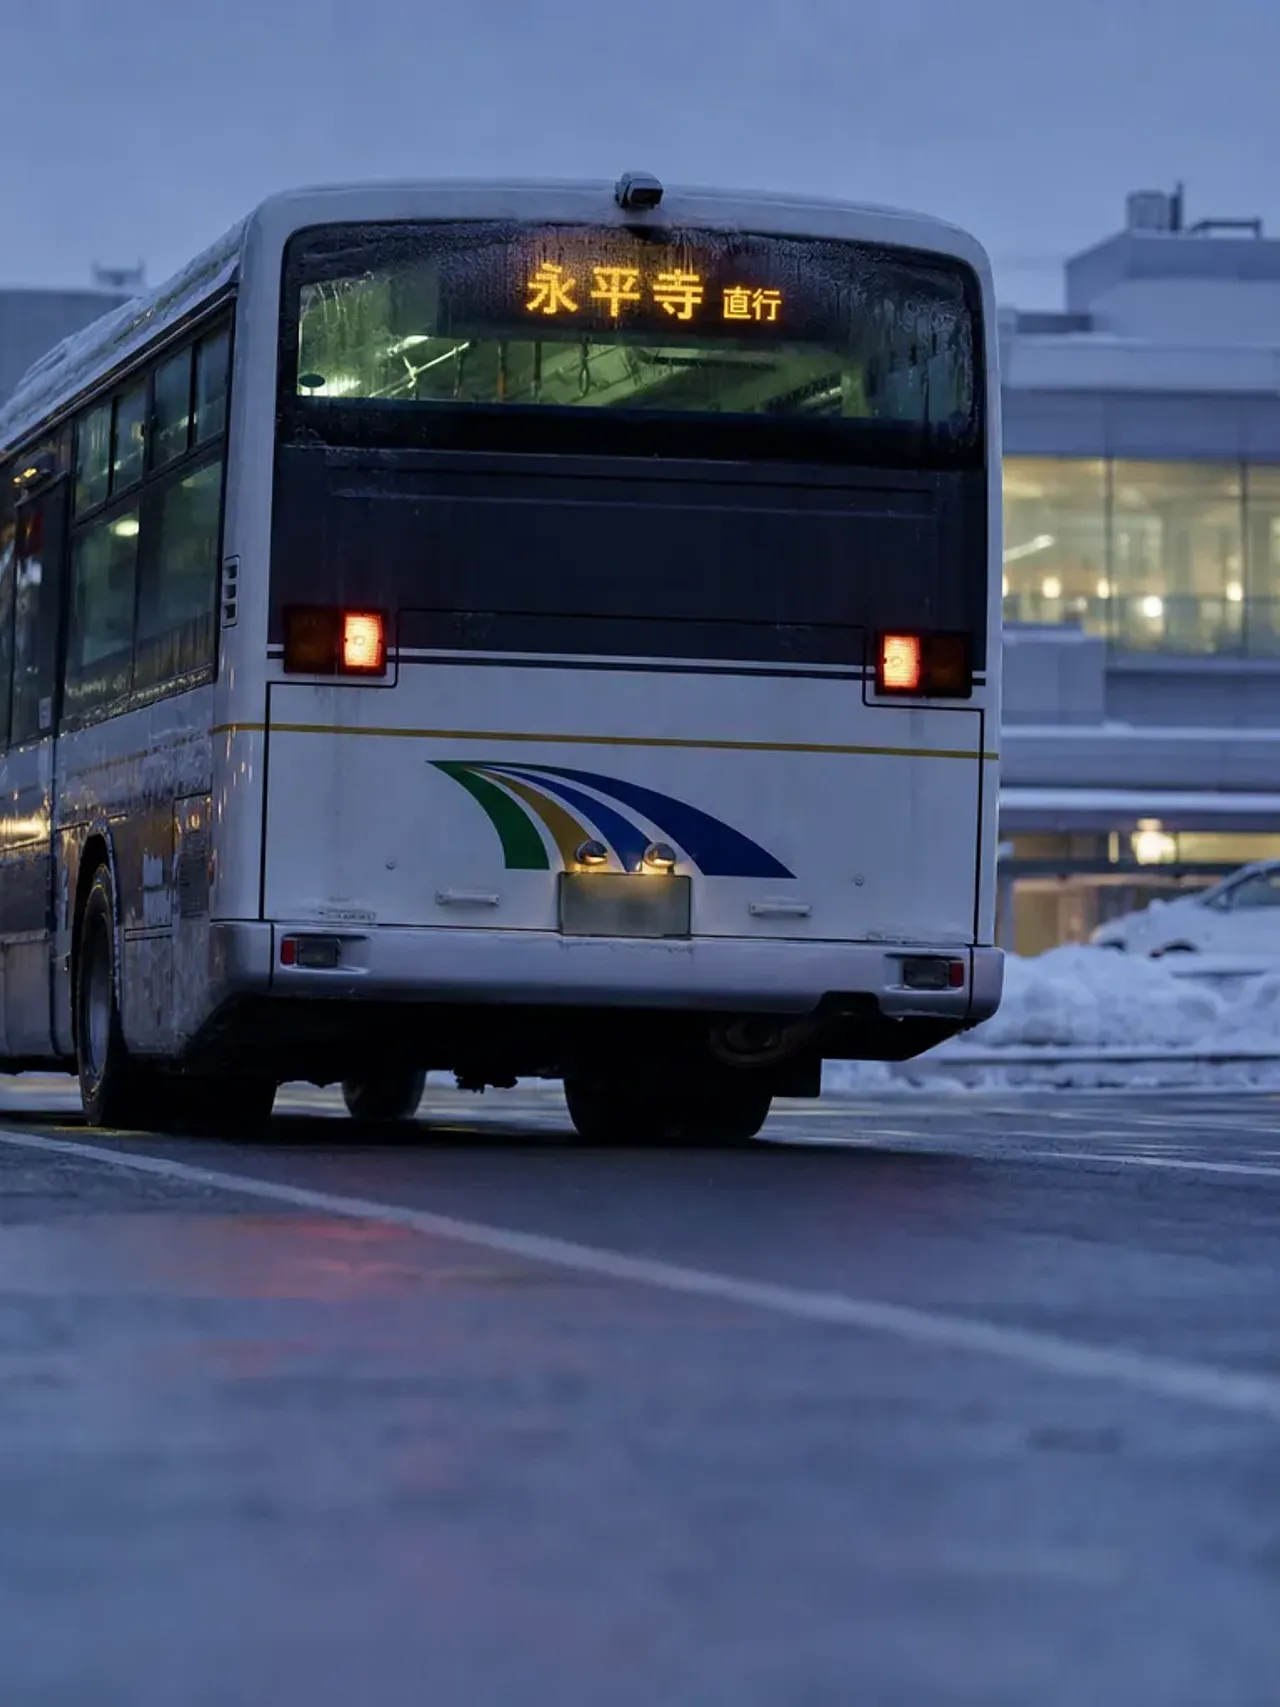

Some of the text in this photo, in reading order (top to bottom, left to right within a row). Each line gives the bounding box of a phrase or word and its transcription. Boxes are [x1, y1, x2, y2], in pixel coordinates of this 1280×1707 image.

[526, 261, 782, 321] 永平寺 直行
